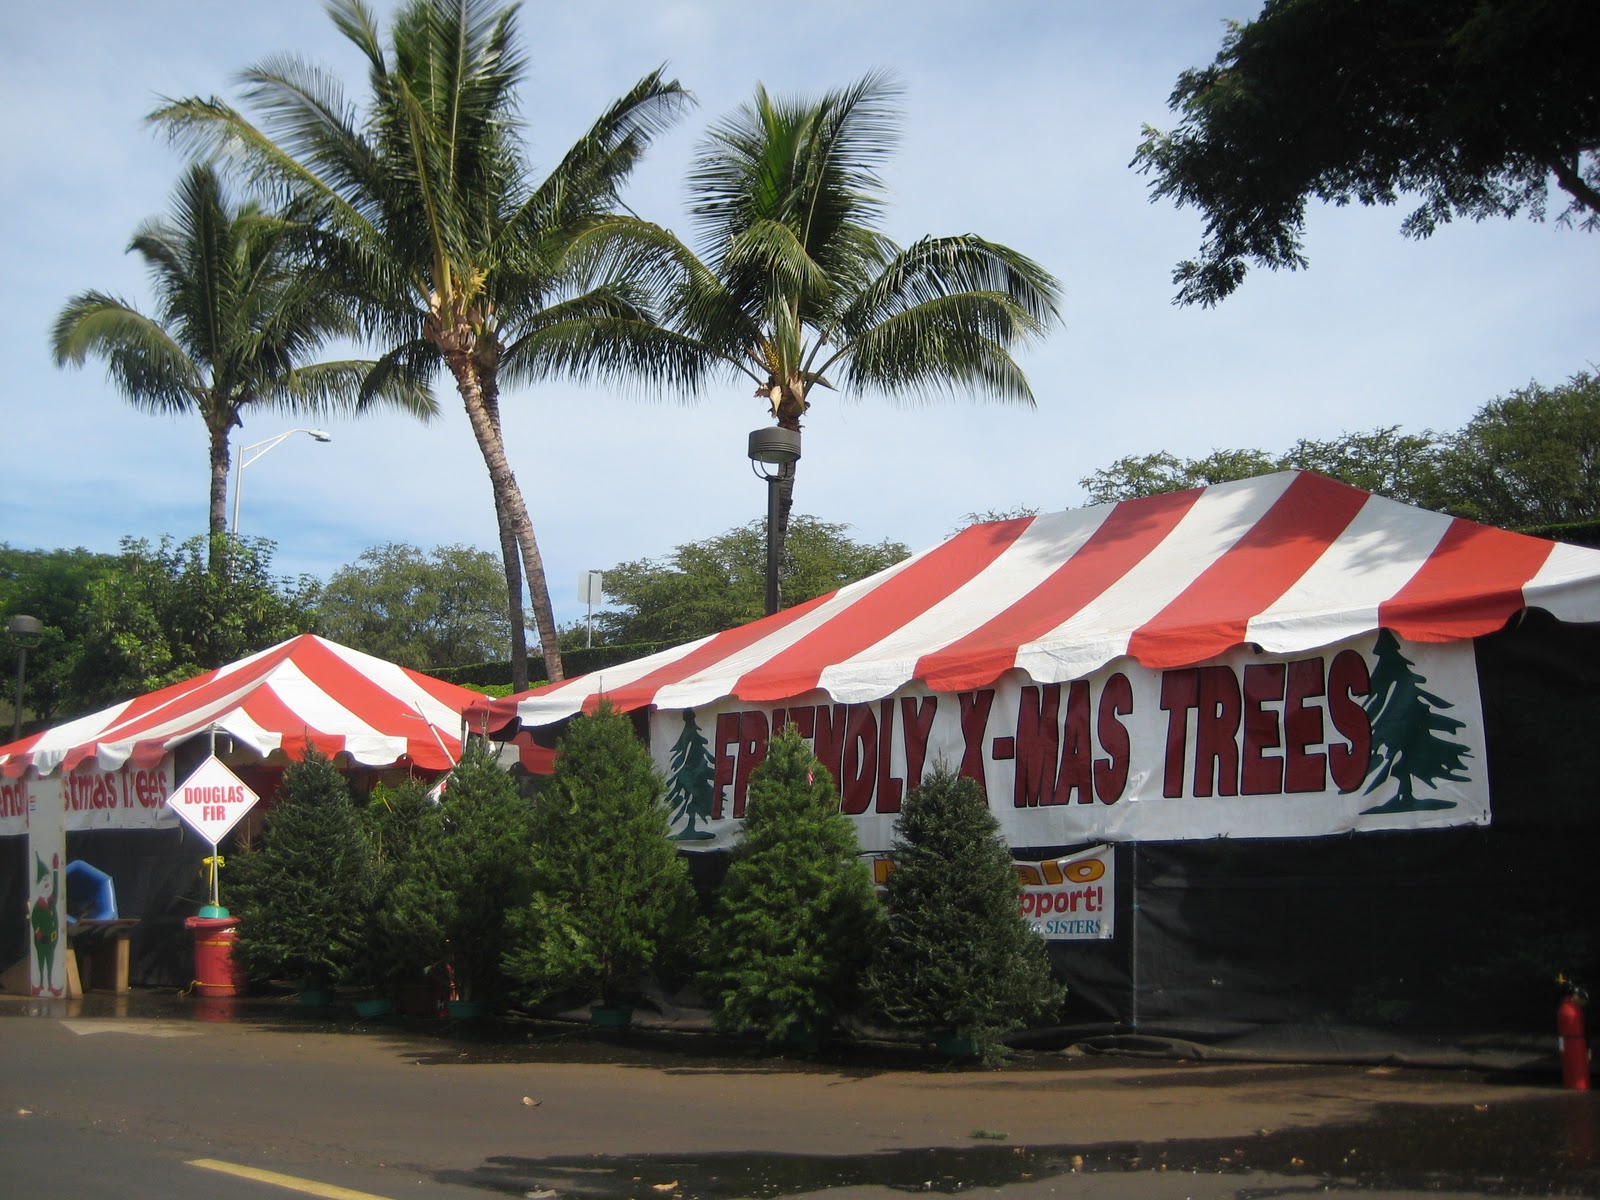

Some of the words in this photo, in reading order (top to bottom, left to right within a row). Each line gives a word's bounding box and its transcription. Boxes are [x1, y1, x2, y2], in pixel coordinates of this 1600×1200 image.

[712, 696, 939, 820] FRNDLY
[957, 672, 1134, 809] X-MAS
[1160, 649, 1372, 798] TREES
[121, 763, 167, 810] Trees
[184, 786, 245, 805] DOUGLAS
[203, 805, 227, 822] FIR
[1013, 885, 1103, 918] pport!
